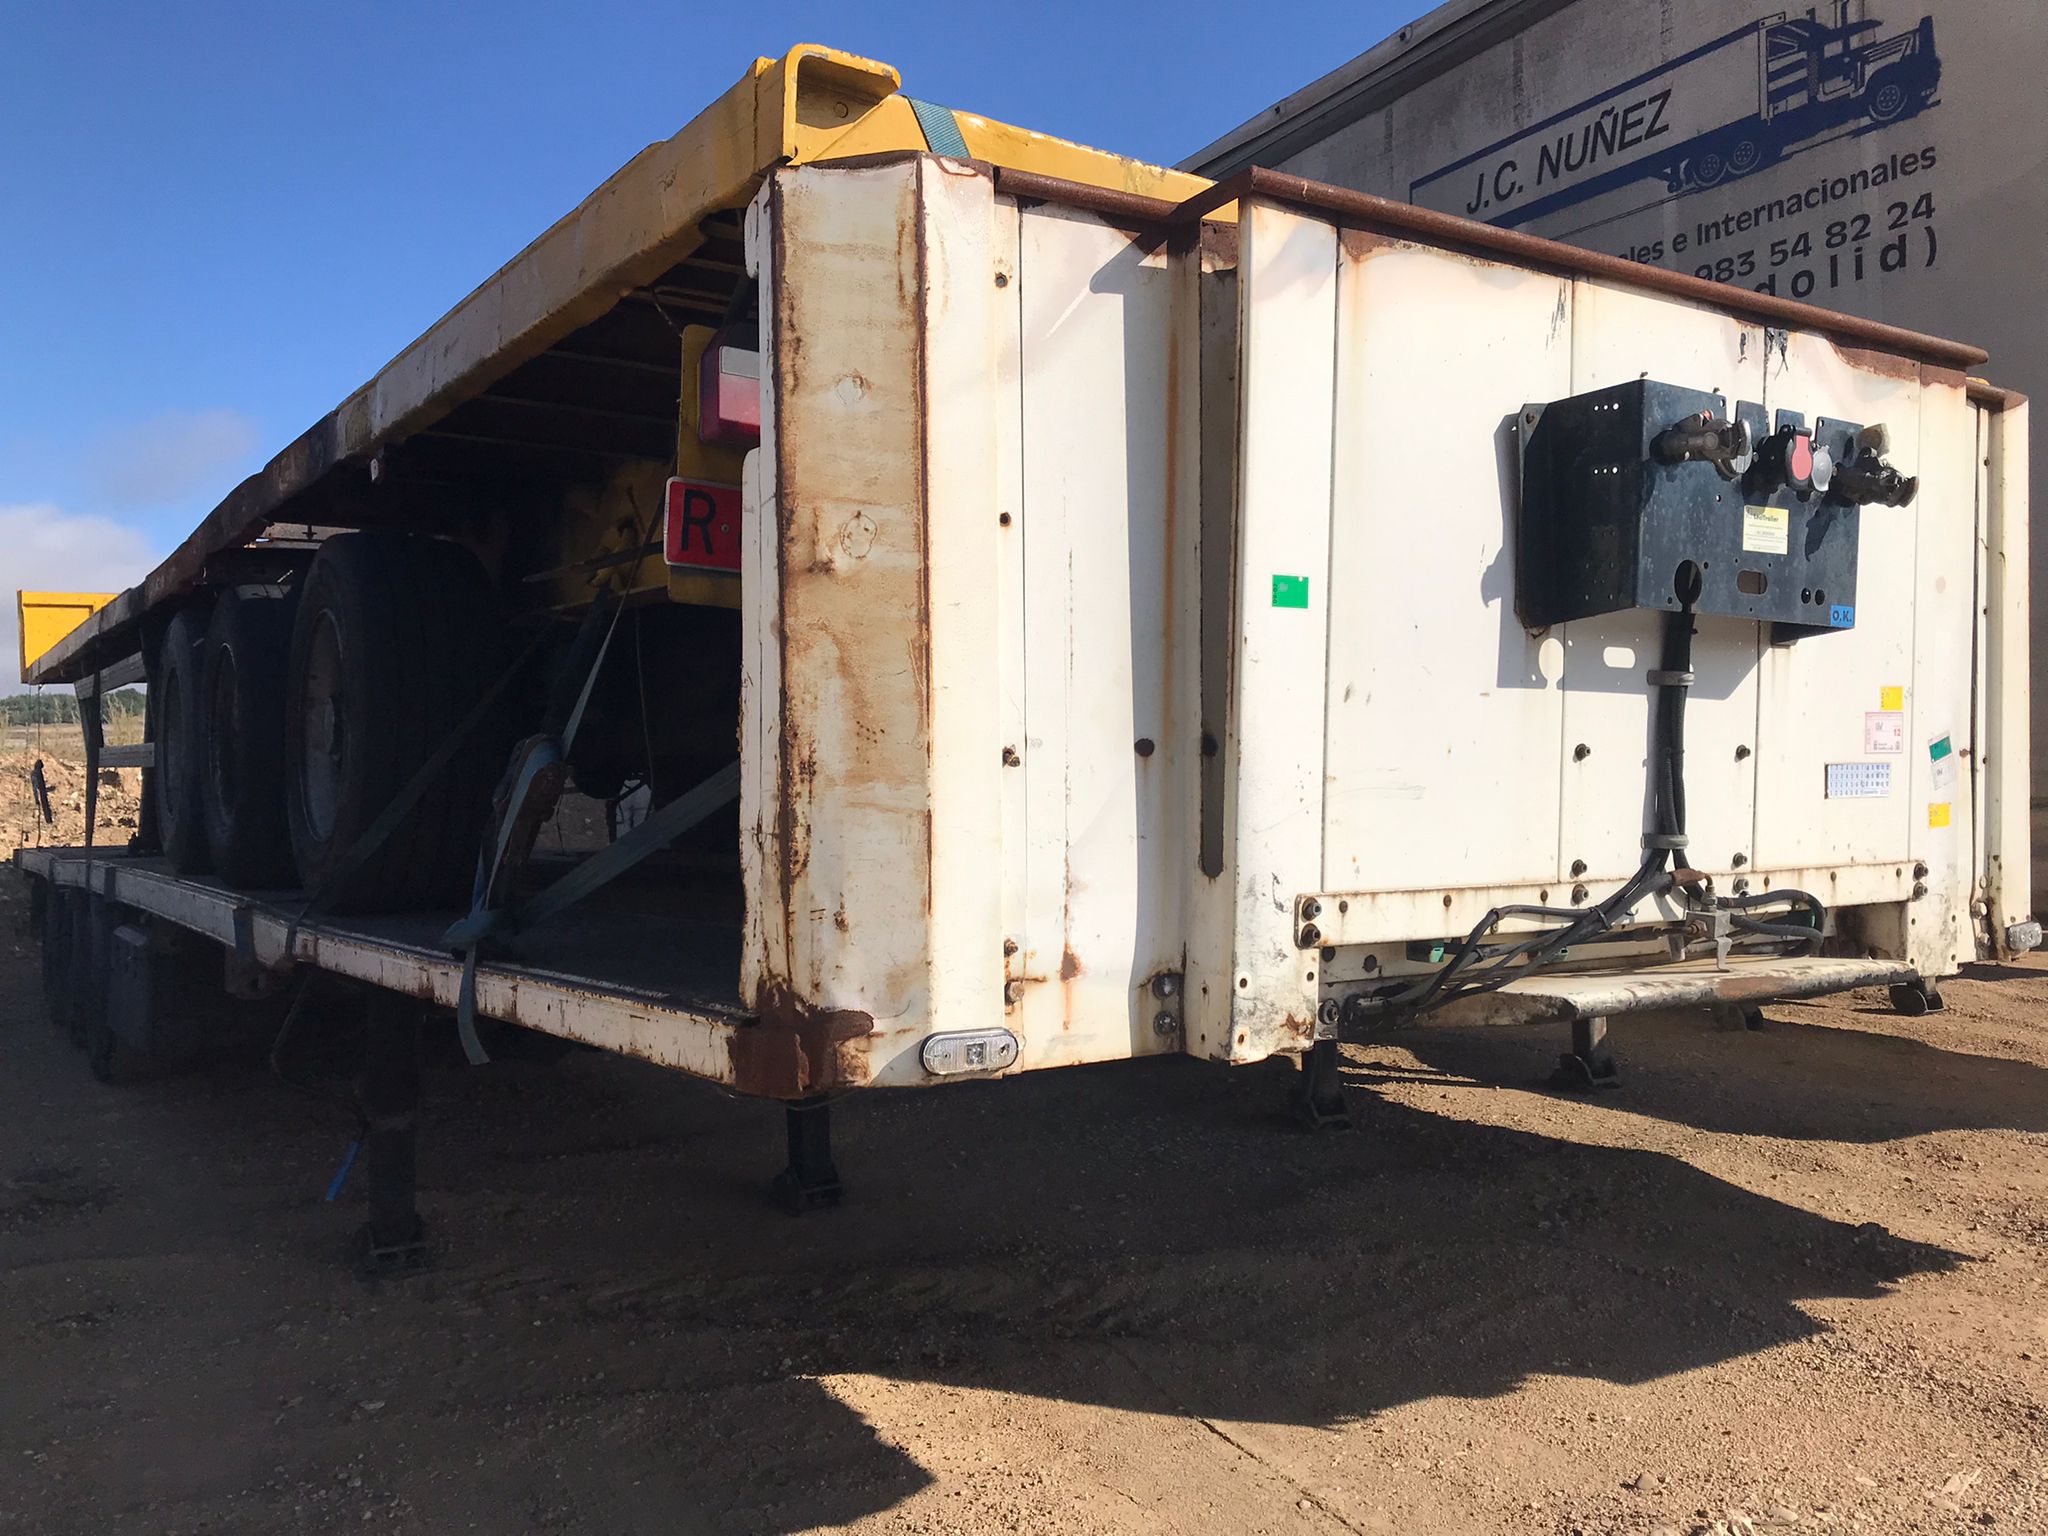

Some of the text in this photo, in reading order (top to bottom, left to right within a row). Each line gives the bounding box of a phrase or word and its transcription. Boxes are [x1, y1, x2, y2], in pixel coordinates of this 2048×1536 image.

[1467, 89, 1671, 214] J.C. NUÑEZ
[1672, 233, 1688, 253] e
[1697, 146, 1937, 246] Internacionales
[1694, 192, 1936, 283] 983 54 82 24
[680, 488, 716, 555] R
[1832, 610, 1852, 622] O.K.
